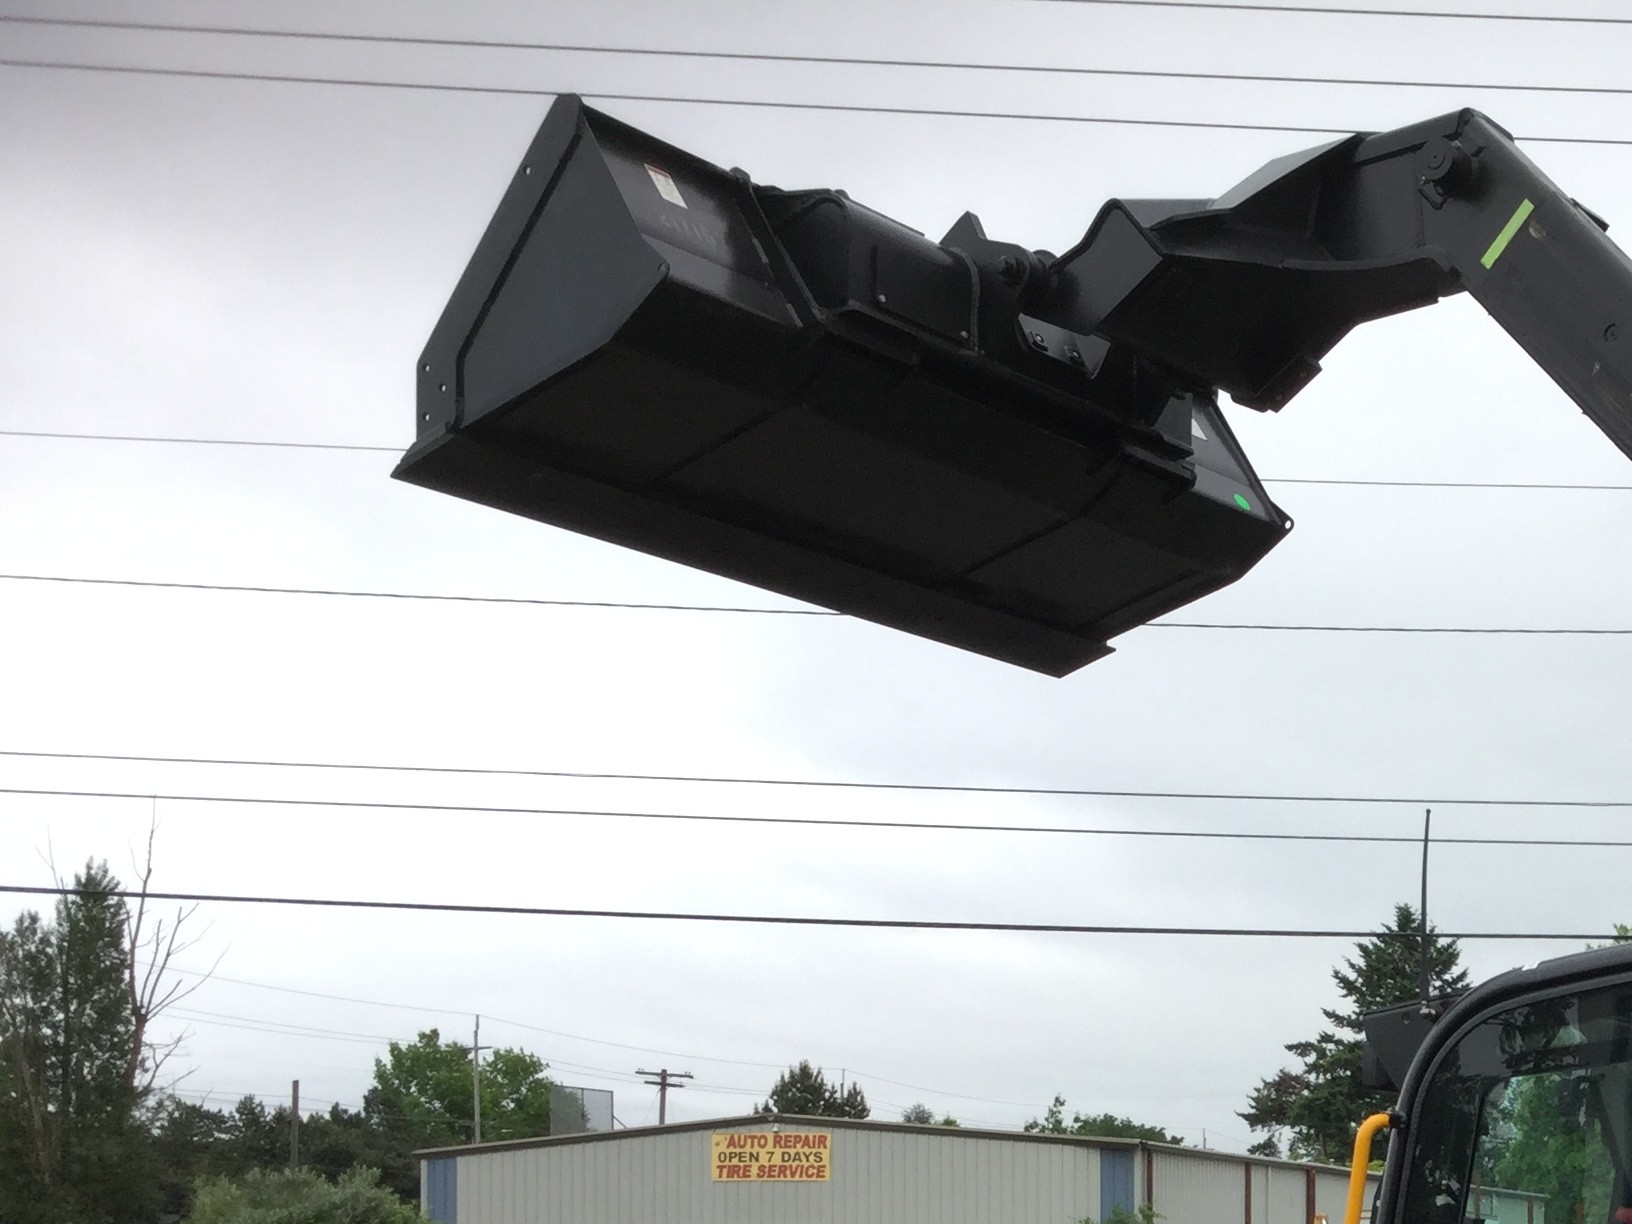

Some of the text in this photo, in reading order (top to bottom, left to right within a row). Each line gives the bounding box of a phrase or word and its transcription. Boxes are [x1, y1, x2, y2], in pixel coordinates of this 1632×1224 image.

[726, 1134, 828, 1149] AUTO REPAIR
[717, 1151, 823, 1163] OPEN 7 DAYS
[716, 1164, 826, 1178] TIRE SERVICE
